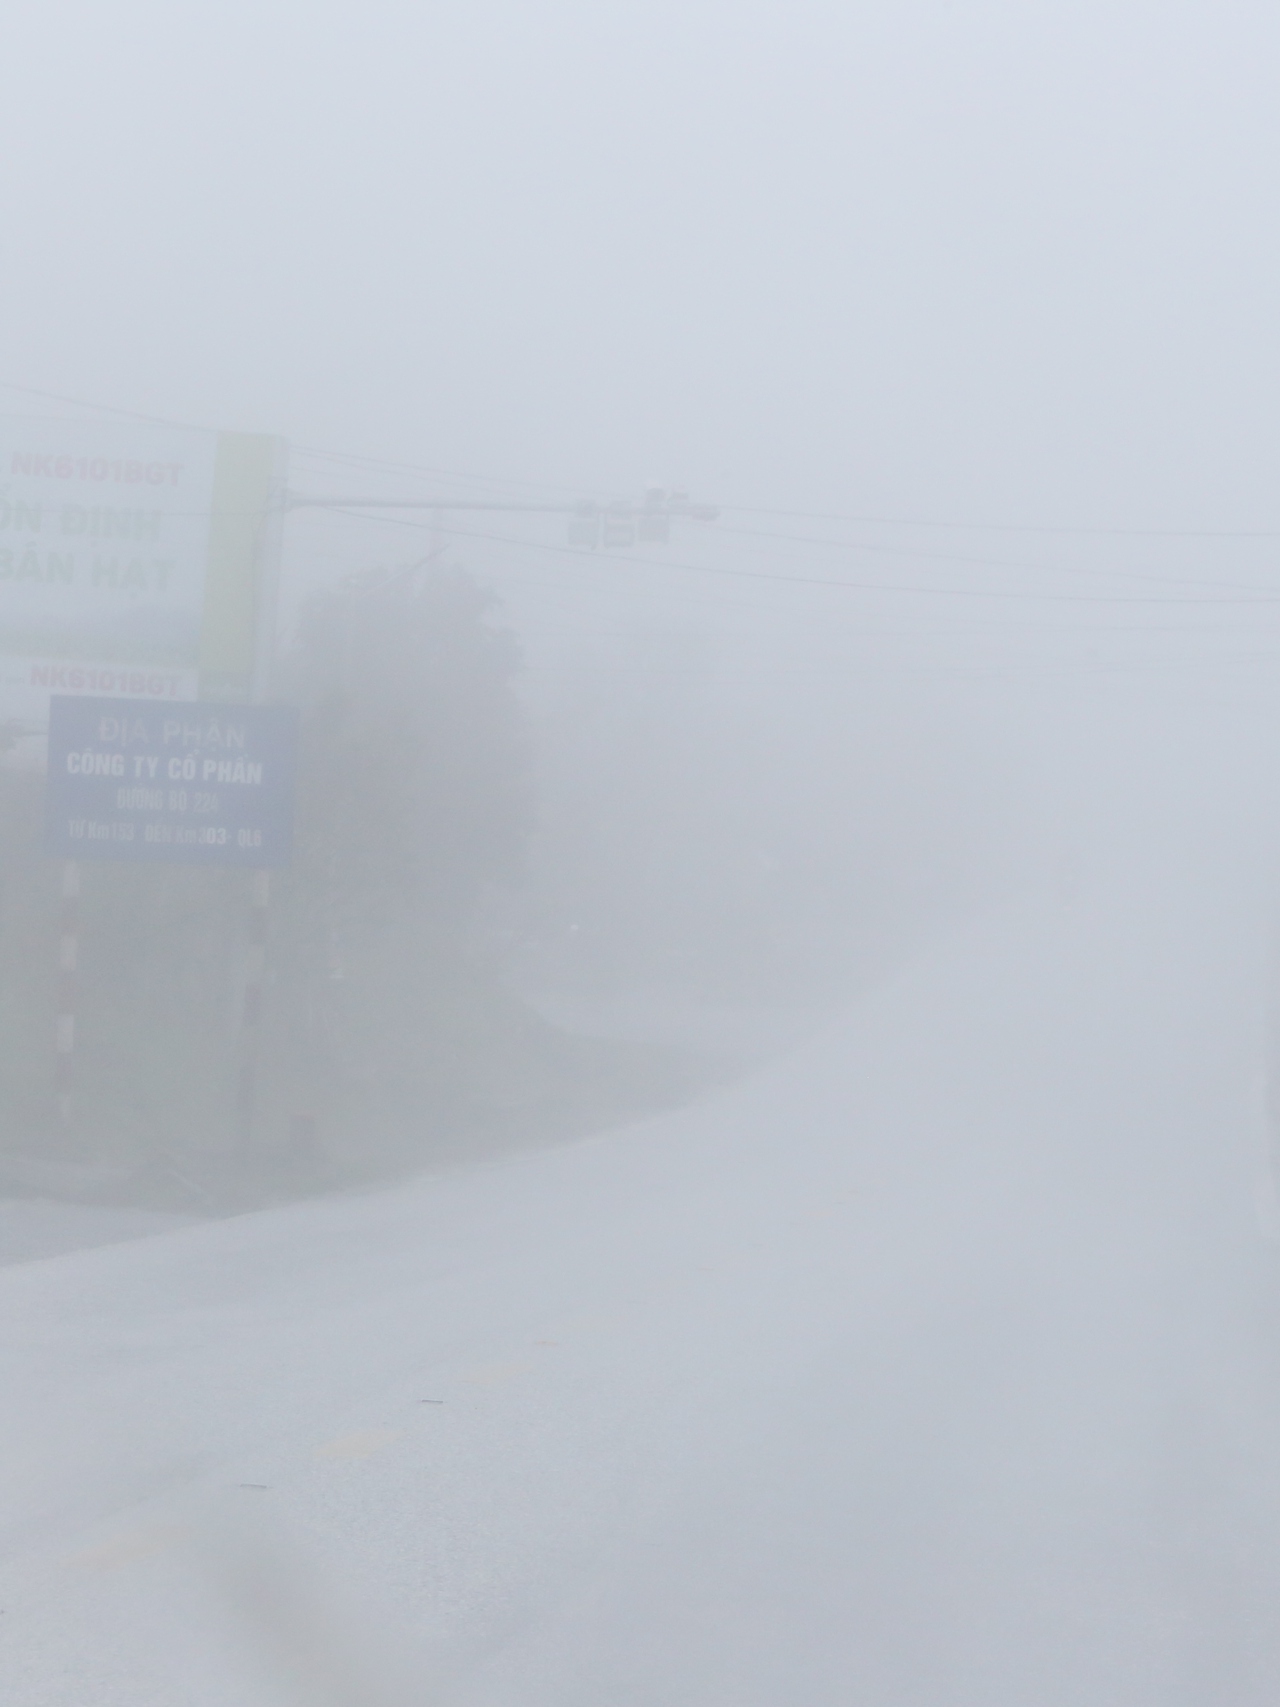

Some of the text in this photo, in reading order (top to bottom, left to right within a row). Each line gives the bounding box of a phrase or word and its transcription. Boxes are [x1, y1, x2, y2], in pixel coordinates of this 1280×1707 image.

[11, 452, 184, 487] NK6101BGT
[60, 503, 163, 547] ĐỊNH
[91, 555, 177, 599] HẠT
[30, 664, 182, 697] NK6101BGT
[99, 716, 150, 747] ĐỊA
[67, 747, 125, 777] CÔNG
[133, 756, 160, 778] TY
